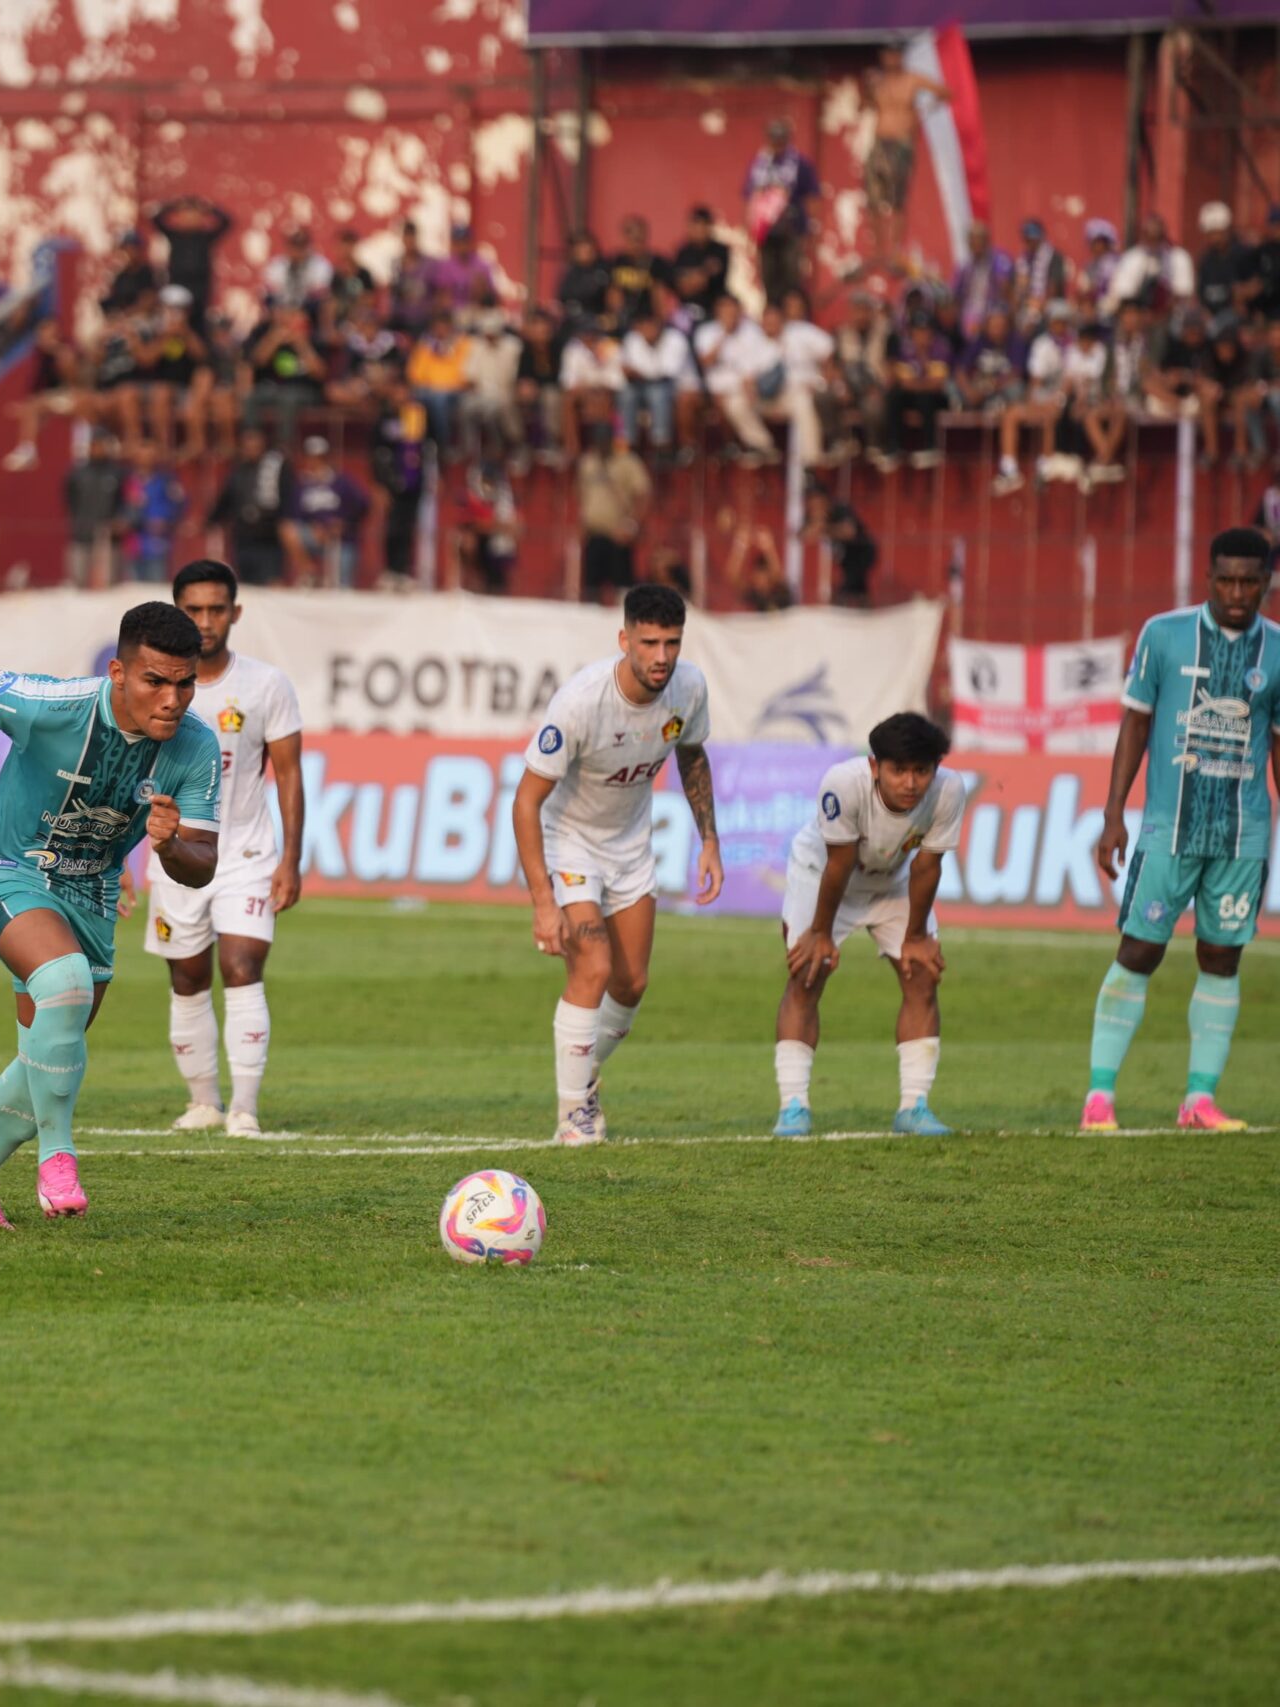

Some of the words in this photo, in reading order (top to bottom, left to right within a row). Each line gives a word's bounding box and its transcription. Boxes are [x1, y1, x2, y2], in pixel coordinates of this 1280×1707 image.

[328, 654, 566, 714] FOOTBA
[42, 810, 134, 836] NUSATU
[60, 857, 88, 871] BANK
[245, 896, 267, 917] 37
[465, 1192, 496, 1225] SPECS
